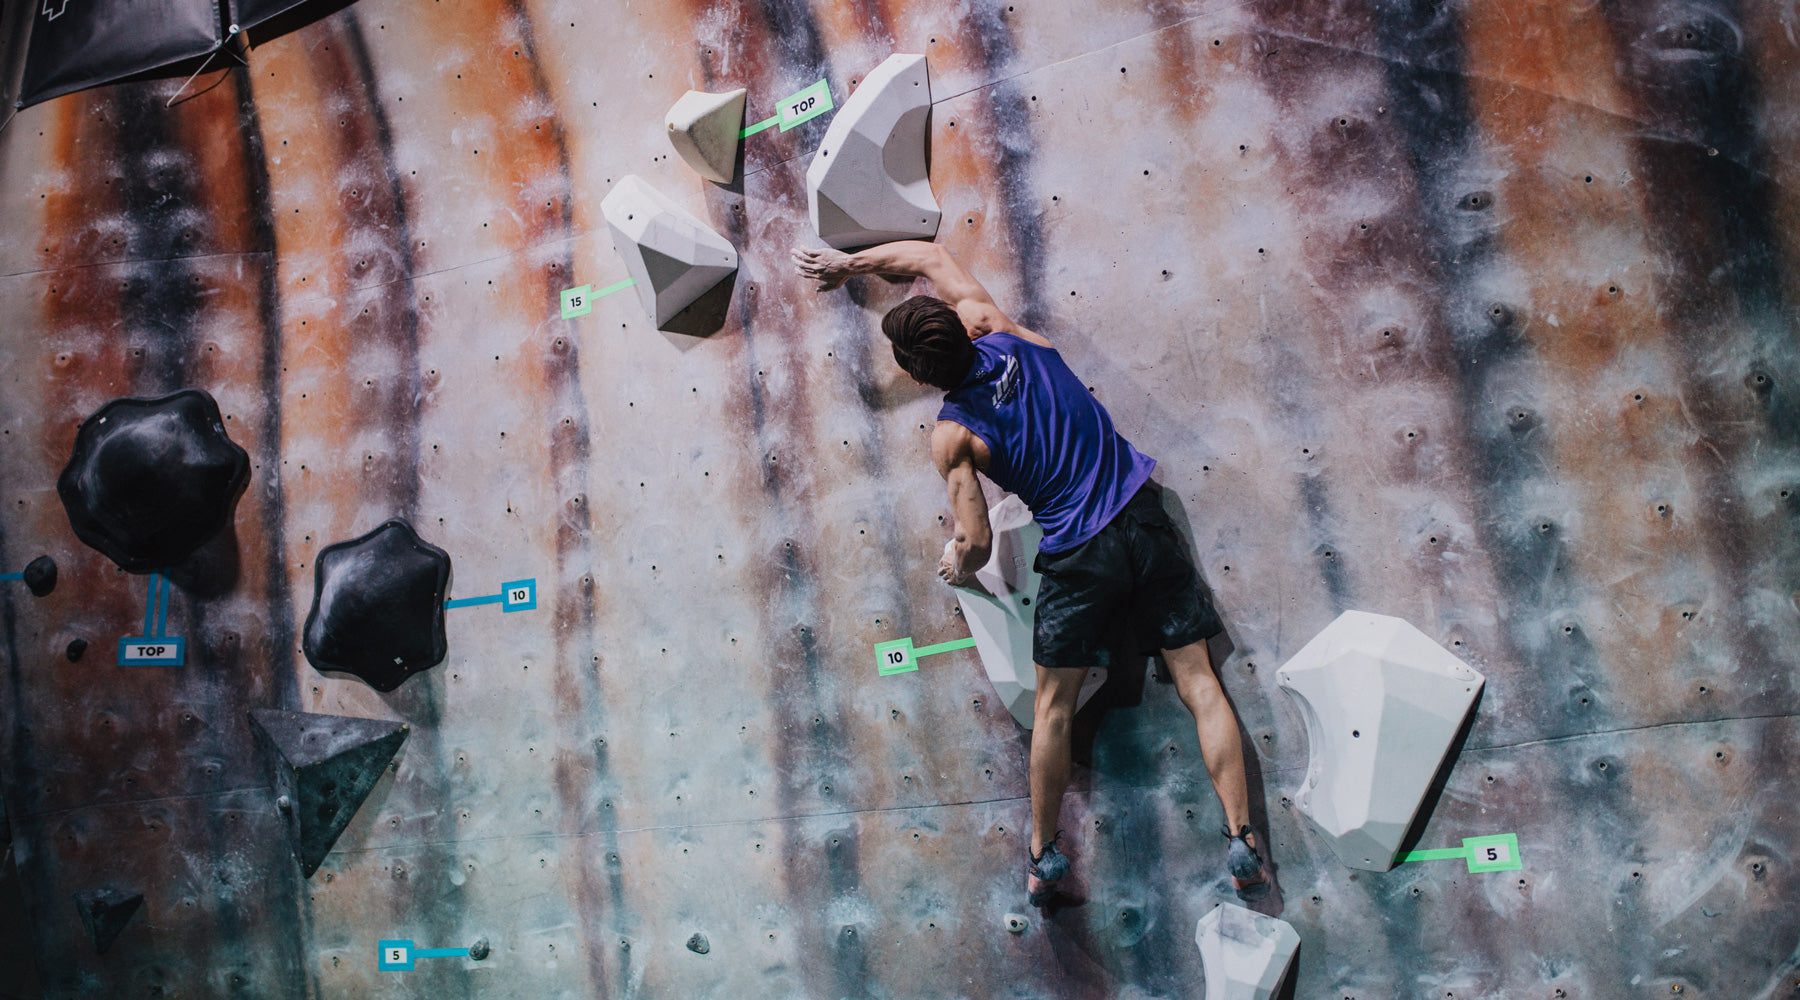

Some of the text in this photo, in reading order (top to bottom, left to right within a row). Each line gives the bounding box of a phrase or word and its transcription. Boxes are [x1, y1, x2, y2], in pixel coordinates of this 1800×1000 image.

[791, 96, 815, 115] TOP
[570, 296, 582, 308] 15
[512, 590, 526, 601] 10
[137, 646, 166, 657] TOP
[887, 652, 903, 664] 10
[1486, 847, 1498, 861] 5
[393, 950, 400, 961] 5
